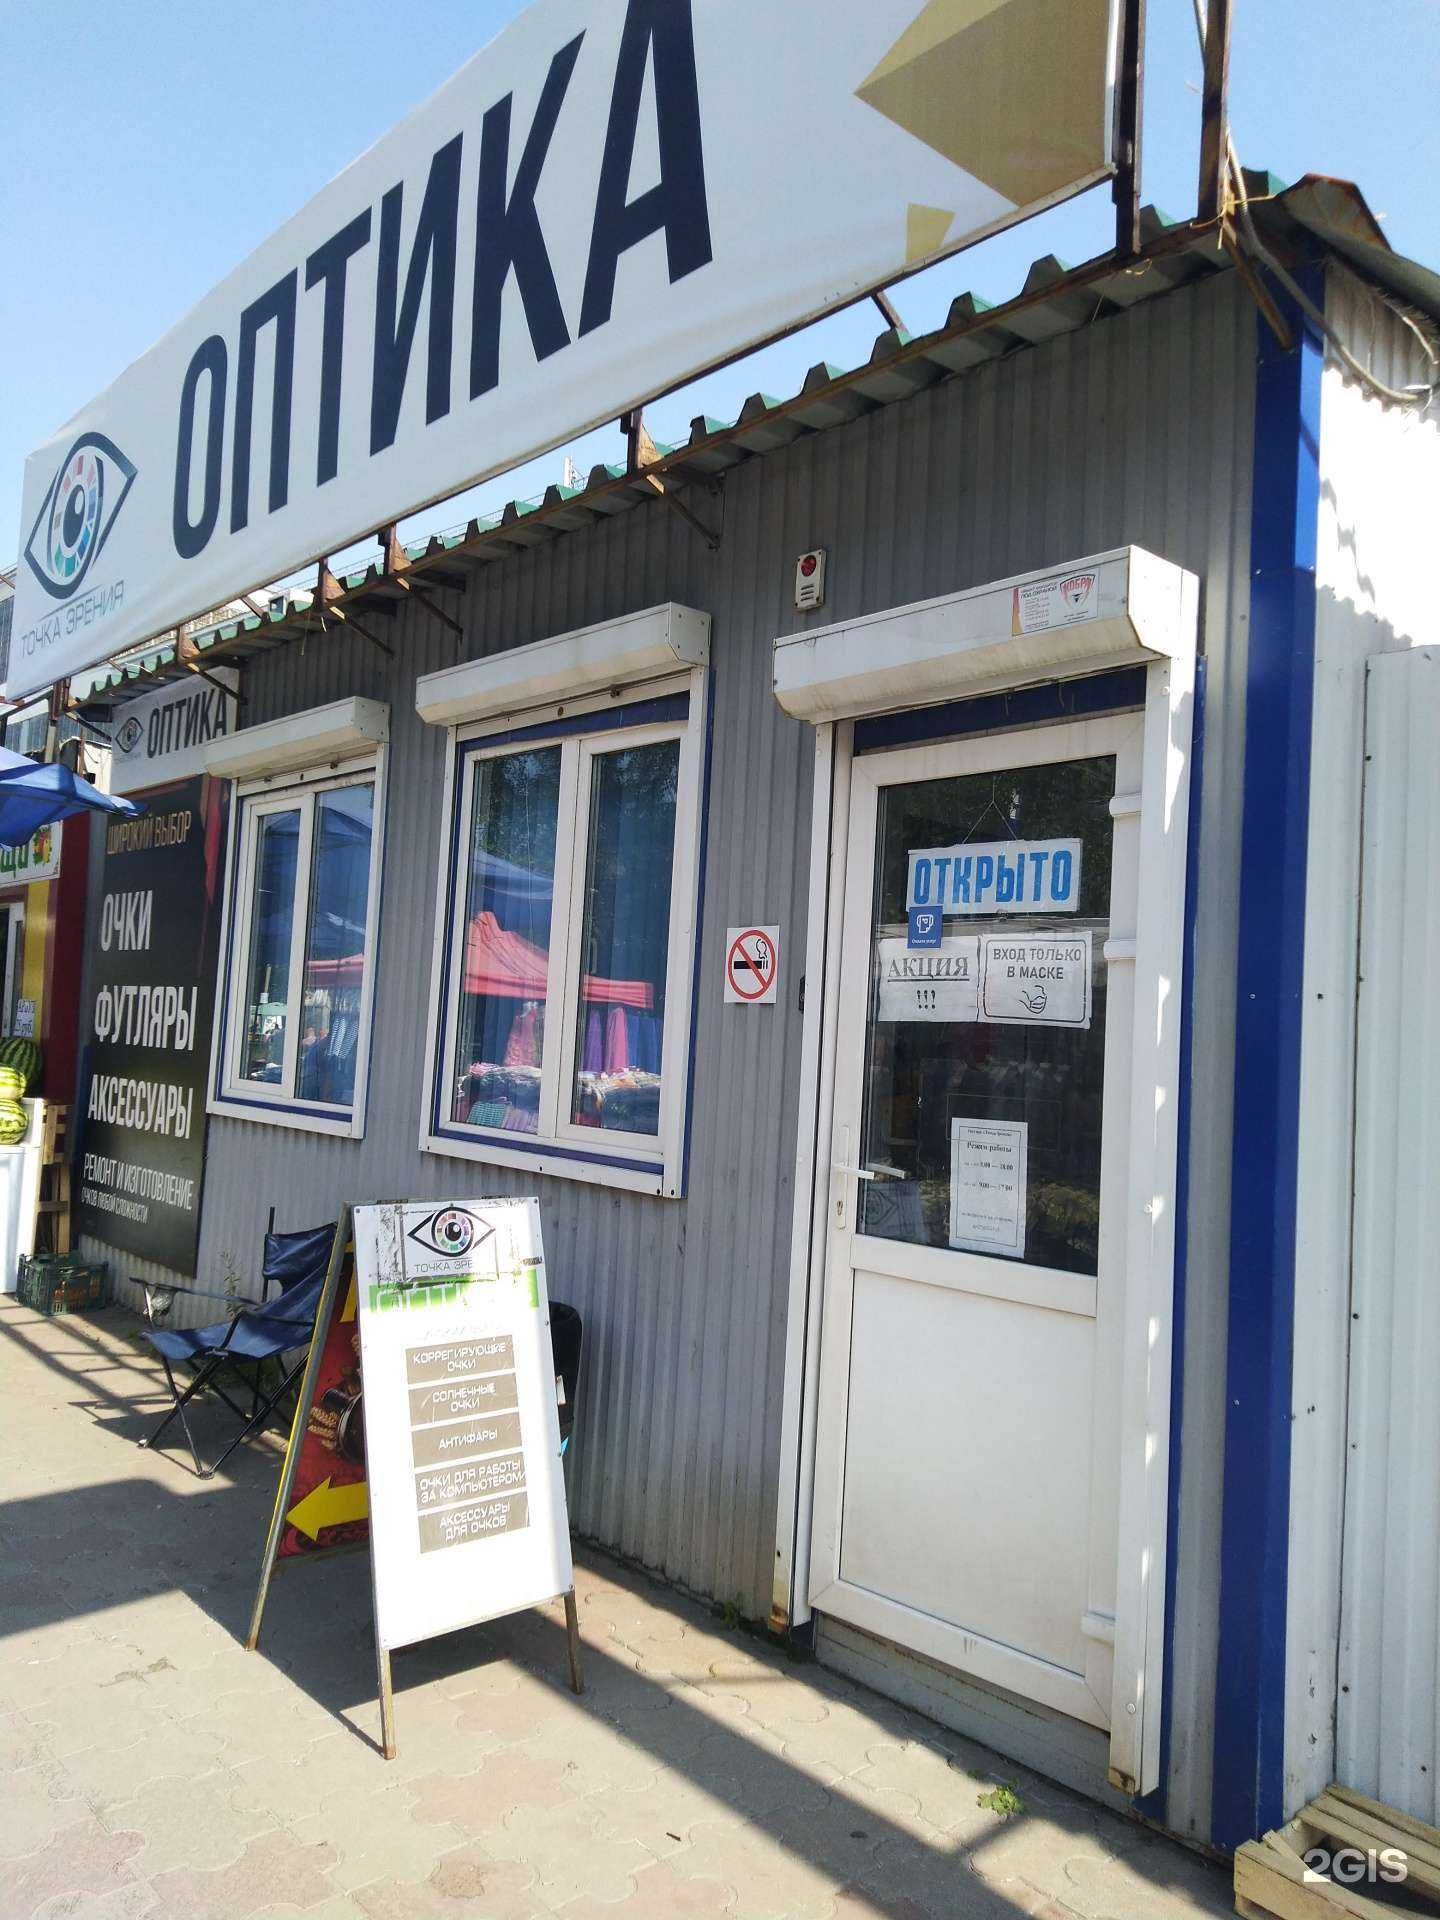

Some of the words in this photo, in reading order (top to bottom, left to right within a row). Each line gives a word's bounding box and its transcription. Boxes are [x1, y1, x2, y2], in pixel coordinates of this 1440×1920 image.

[172, 0, 714, 560] ОПТИКА
[22, 616, 62, 658] ТОЧКА
[65, 579, 124, 635] ЗРЕНИЯ
[147, 684, 228, 759] ОПТИКА
[107, 814, 154, 855] ШИРОКИЙ
[154, 810, 192, 848] ВЫБОР
[913, 849, 1073, 905] ОТКРЫТО
[101, 889, 153, 951] ОЧКИ
[888, 956, 969, 979] АКЦИЯ
[993, 948, 1026, 963] ВХОД
[1029, 947, 1082, 962] ТОЛЬКО
[1006, 966, 1016, 979] В
[1019, 966, 1064, 980] МАСКЕ
[94, 984, 198, 1051] ФУТЛЯРЫ
[87, 1073, 194, 1140] АКСЕССУАРЫ
[83, 1152, 117, 1188] РЕМОНТ
[116, 1161, 125, 1190] И
[124, 1162, 195, 1211] ИЗГОТОВЛЕНИЕ
[414, 1262, 450, 1273] ТОЧКА
[447, 1359, 477, 1372] ОЧКИ
[432, 1382, 497, 1403] СОЛНЕЧНЫЕ
[450, 1398, 480, 1412] ОЧКИ
[438, 1428, 498, 1450] АНТИФАРЫ
[420, 1473, 451, 1491] ОЧКИ
[454, 1467, 476, 1483] ДЛЯ
[478, 1460, 521, 1477] РАБОТЫ
[421, 1491, 437, 1505] ЗА
[439, 1473, 523, 1499] КОМПЬЮТЕРОМ
[440, 1502, 511, 1528] АКСЕССУАРЫ
[445, 1523, 468, 1542] ДЛЯ
[470, 1515, 507, 1534] ОЧКОВ
